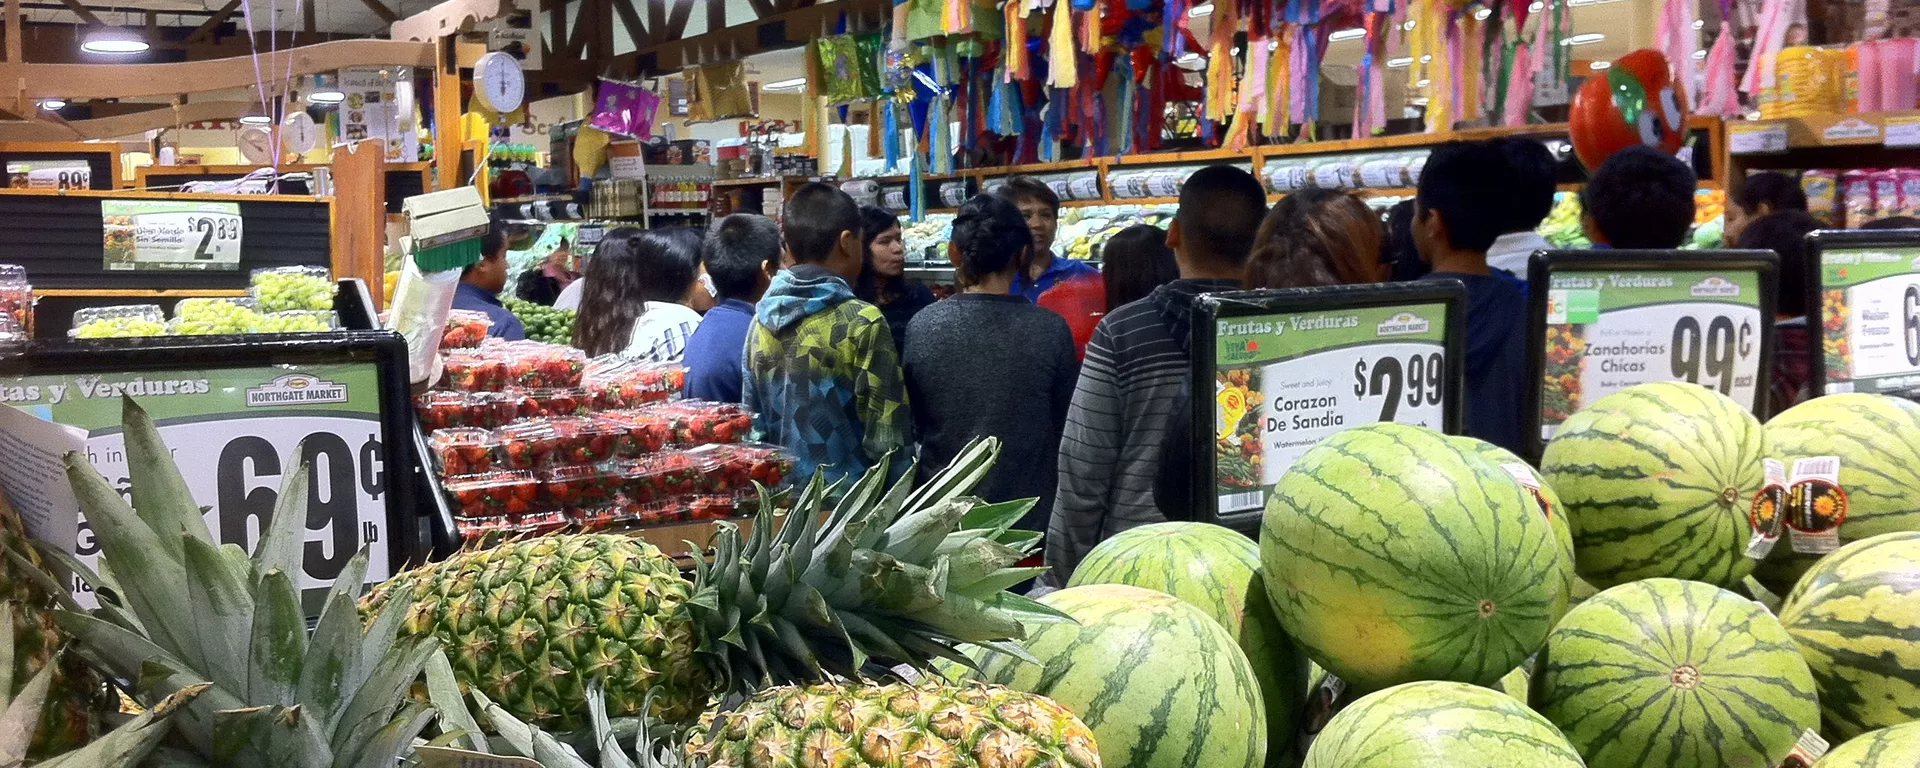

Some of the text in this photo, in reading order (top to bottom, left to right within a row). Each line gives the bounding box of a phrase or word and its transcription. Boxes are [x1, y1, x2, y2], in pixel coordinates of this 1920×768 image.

[1597, 278, 1606, 291] y
[1609, 273, 1674, 288] Verduras
[1216, 315, 1359, 336] Frutas y Verduras
[1585, 341, 1665, 356] Zanahorias
[1601, 358, 1646, 372] Chicas
[50, 382, 67, 403] y
[75, 377, 209, 398] Verduras
[1281, 381, 1300, 390] Sweet
[1302, 379, 1314, 388] and
[252, 389, 342, 402] NORTHGATE MARKET
[1274, 396, 1337, 412] Corazon
[1267, 411, 1344, 432] De Sandia
[1273, 439, 1317, 449] Watermelon
[107, 447, 122, 463] in
[363, 521, 378, 543] lb
